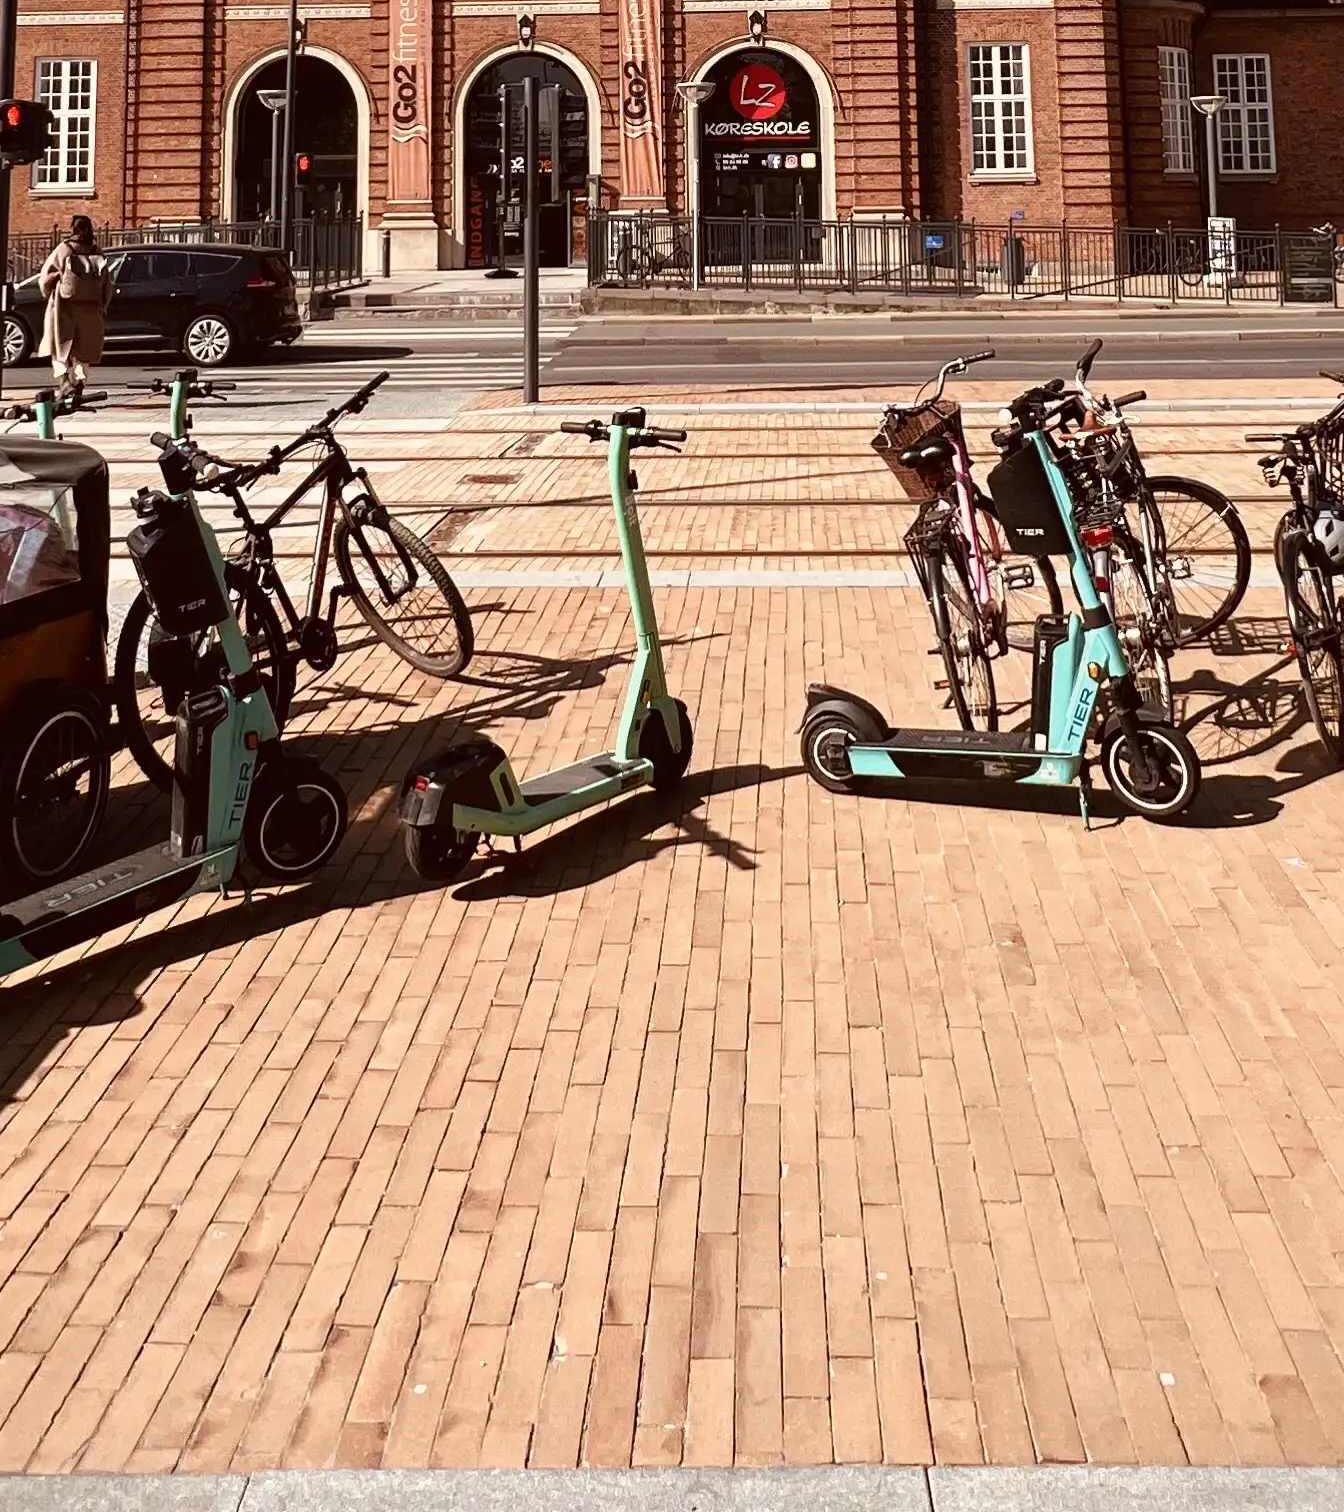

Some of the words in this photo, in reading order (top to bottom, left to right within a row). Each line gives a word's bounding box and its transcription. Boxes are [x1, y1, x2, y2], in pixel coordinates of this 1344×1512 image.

[739, 75, 776, 107] LZ
[704, 120, 811, 136] KØRESKOLE
[1016, 528, 1045, 536] TIER
[178, 598, 206, 613] TIER
[1039, 639, 1047, 665] TIER
[1067, 687, 1094, 742] TIER
[228, 761, 253, 831] TIER
